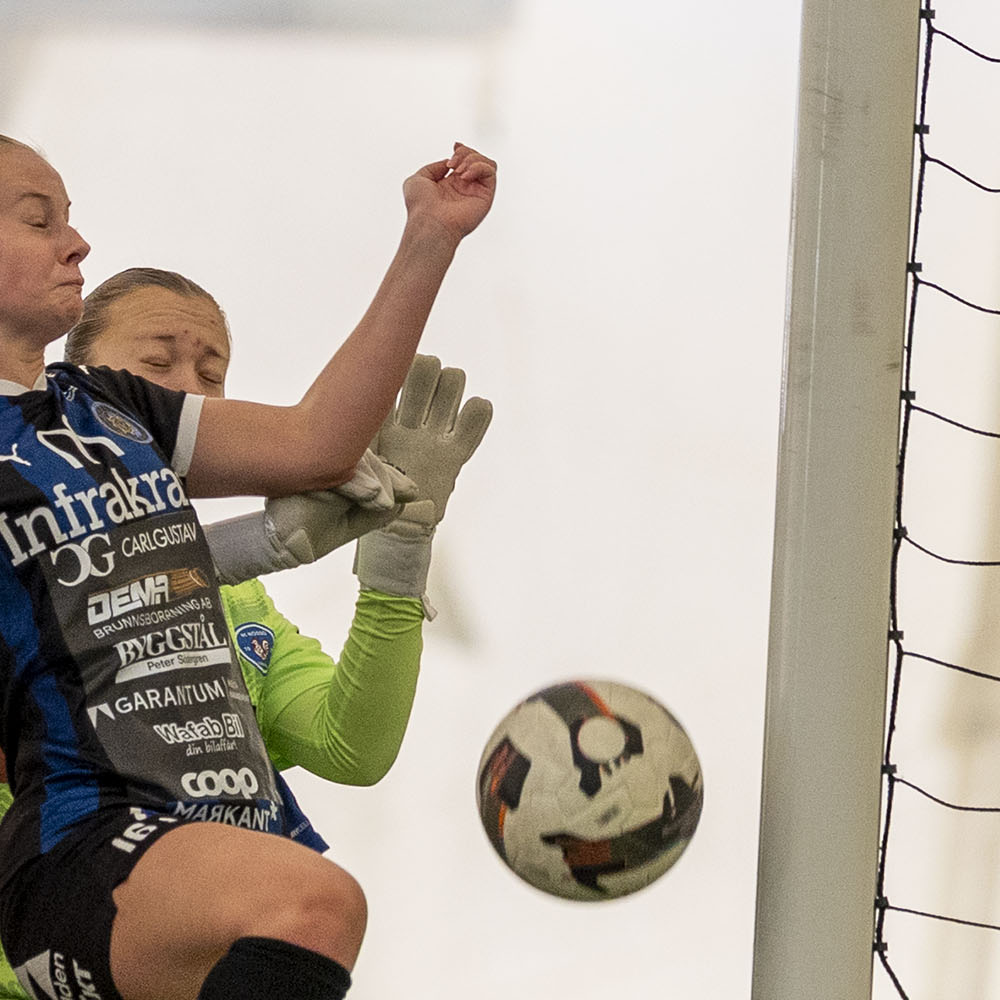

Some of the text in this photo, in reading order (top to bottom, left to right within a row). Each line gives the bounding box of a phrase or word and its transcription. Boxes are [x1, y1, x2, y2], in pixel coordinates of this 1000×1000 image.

[87, 574, 169, 626] DEMA
[93, 599, 200, 640] BRUNNSBORRNING
[113, 614, 228, 668] BYGGSTÅL
[147, 658, 175, 671] Peter
[115, 679, 226, 714] GARANTUM
[153, 713, 245, 744] Wafab Bil
[186, 743, 203, 757] din
